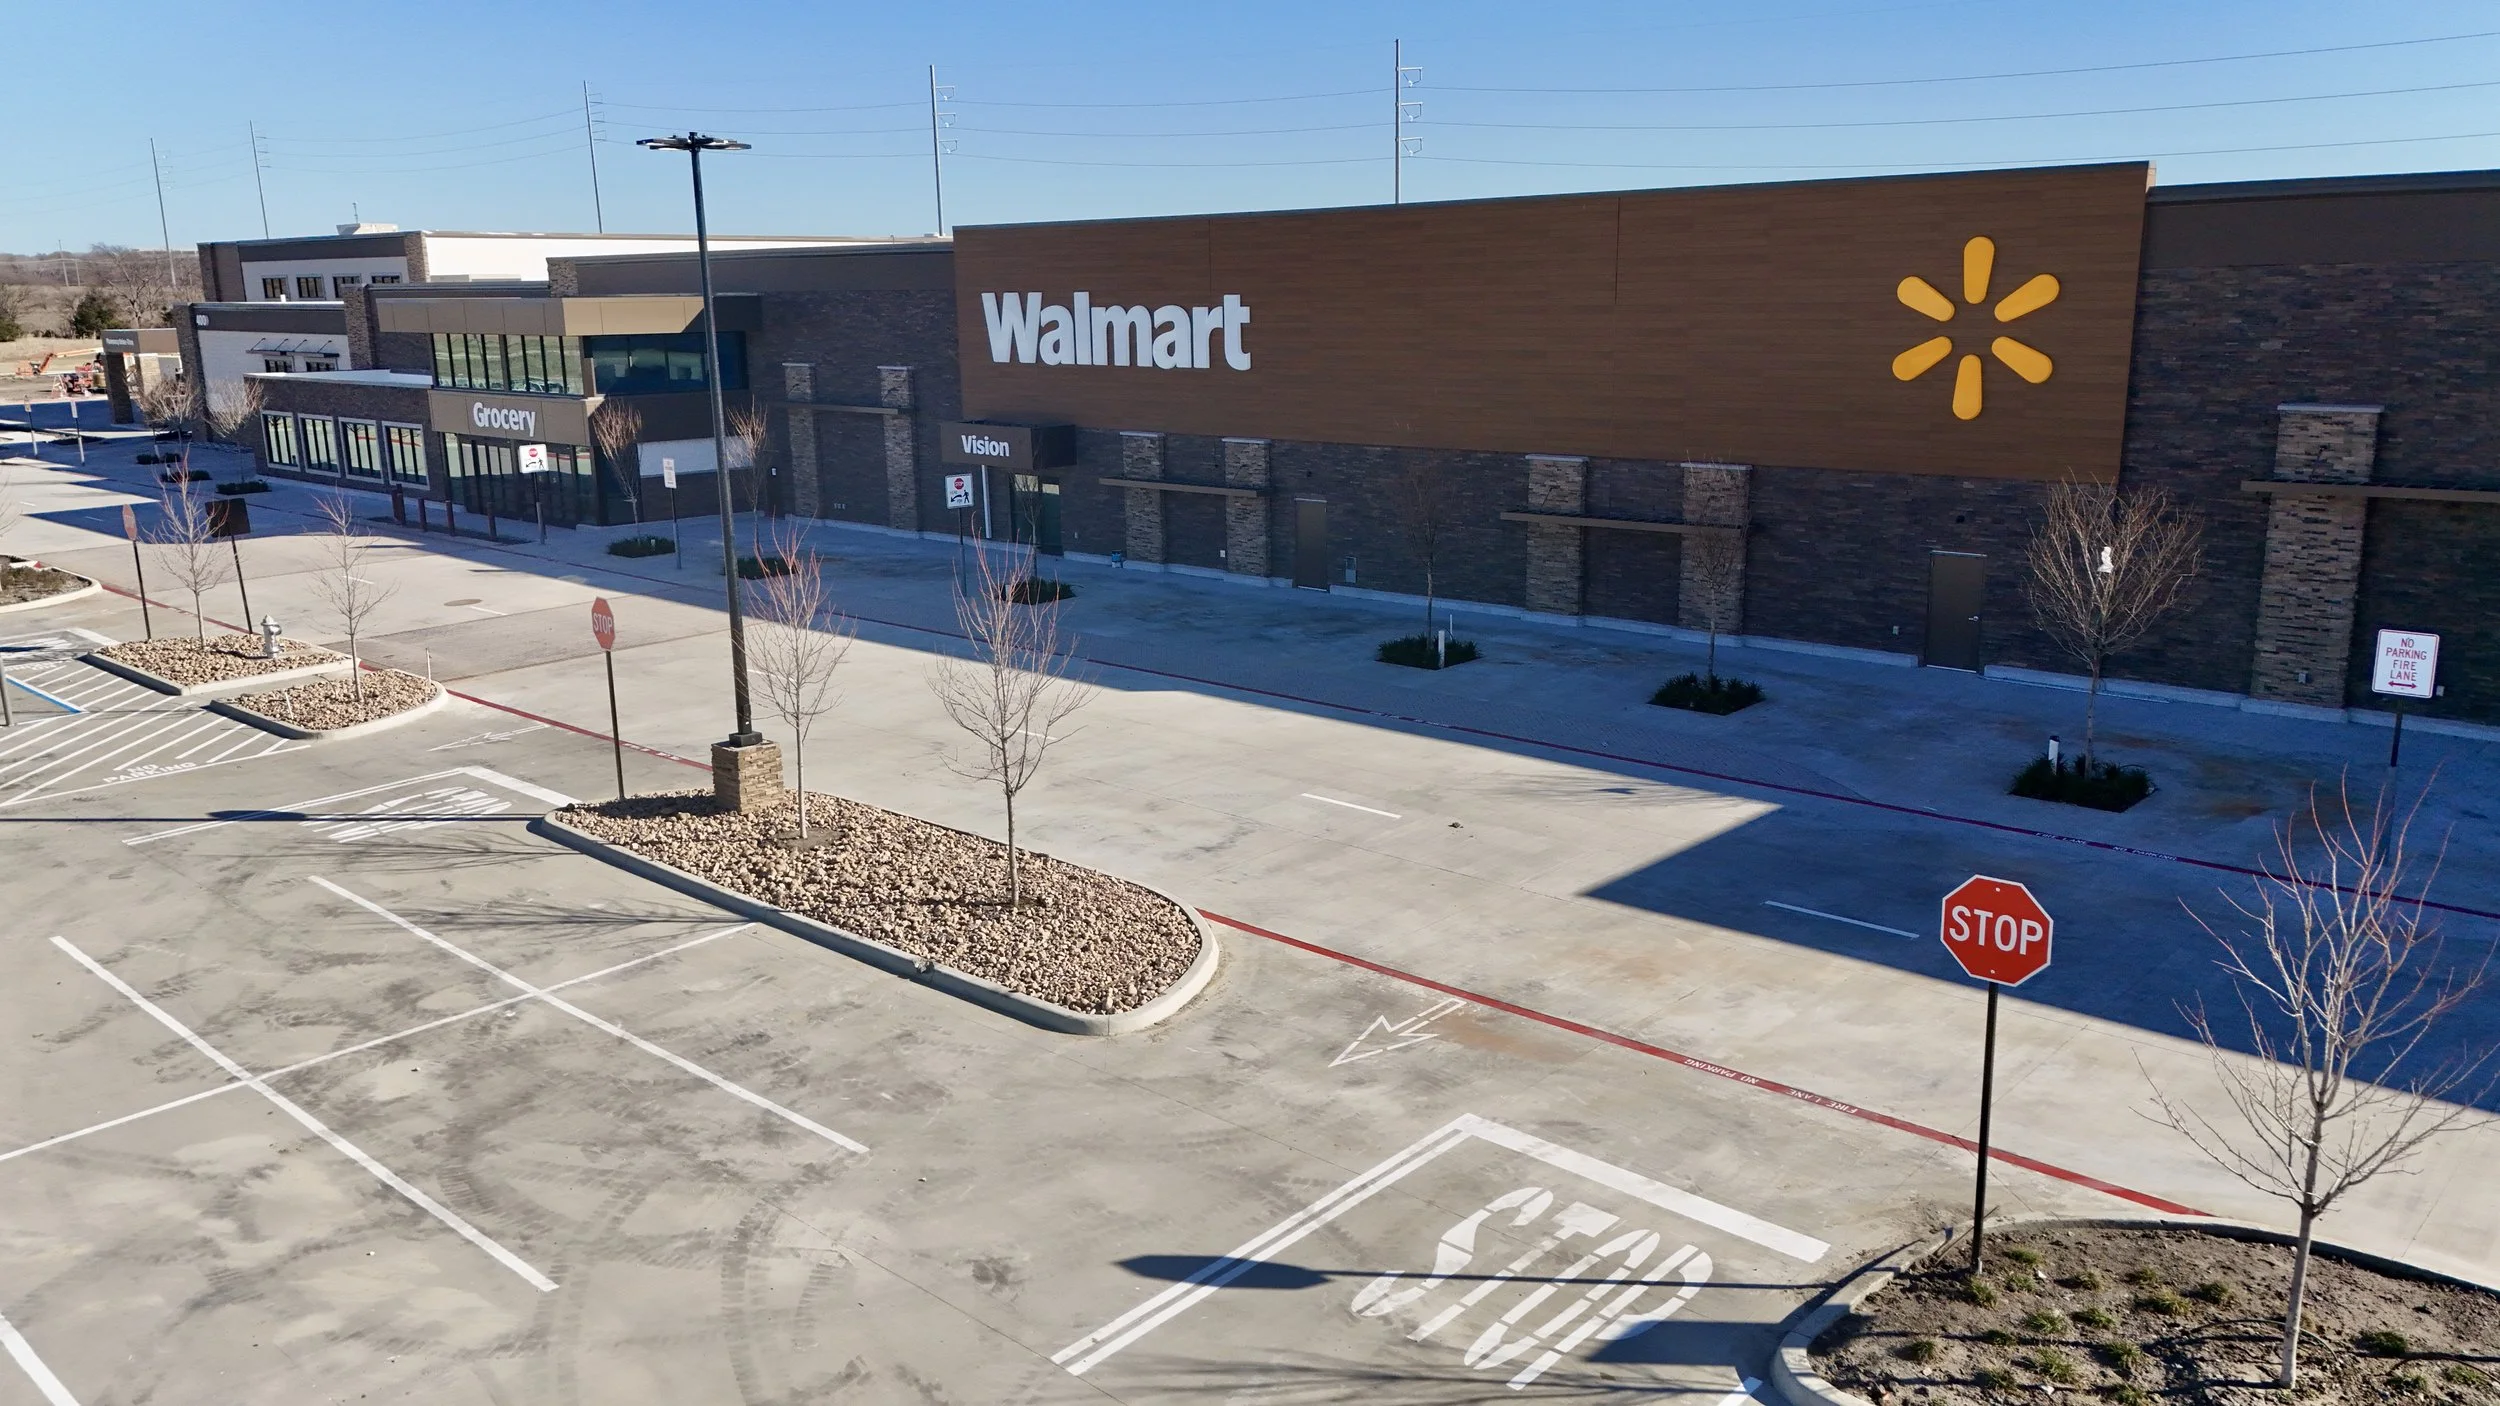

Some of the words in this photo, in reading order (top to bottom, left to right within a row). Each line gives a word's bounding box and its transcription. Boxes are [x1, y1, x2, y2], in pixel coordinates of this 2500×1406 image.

[981, 291, 1252, 371] Walmart
[473, 401, 536, 438] Grocery
[961, 434, 1010, 457] Vision
[592, 612, 613, 635] STOP
[2385, 647, 2428, 660] PARKING
[2400, 638, 2415, 649] NO
[2393, 659, 2417, 671] FIRE
[2390, 670, 2418, 682] LANE
[102, 761, 197, 783] PARKING
[1949, 905, 2044, 956] STOP
[1684, 1058, 1737, 1079] PARKING
[1740, 1075, 1760, 1086] NO
[1787, 1088, 1821, 1103] LANE
[1825, 1100, 1859, 1115] FIRE
[1350, 1186, 1714, 1392] STOP
